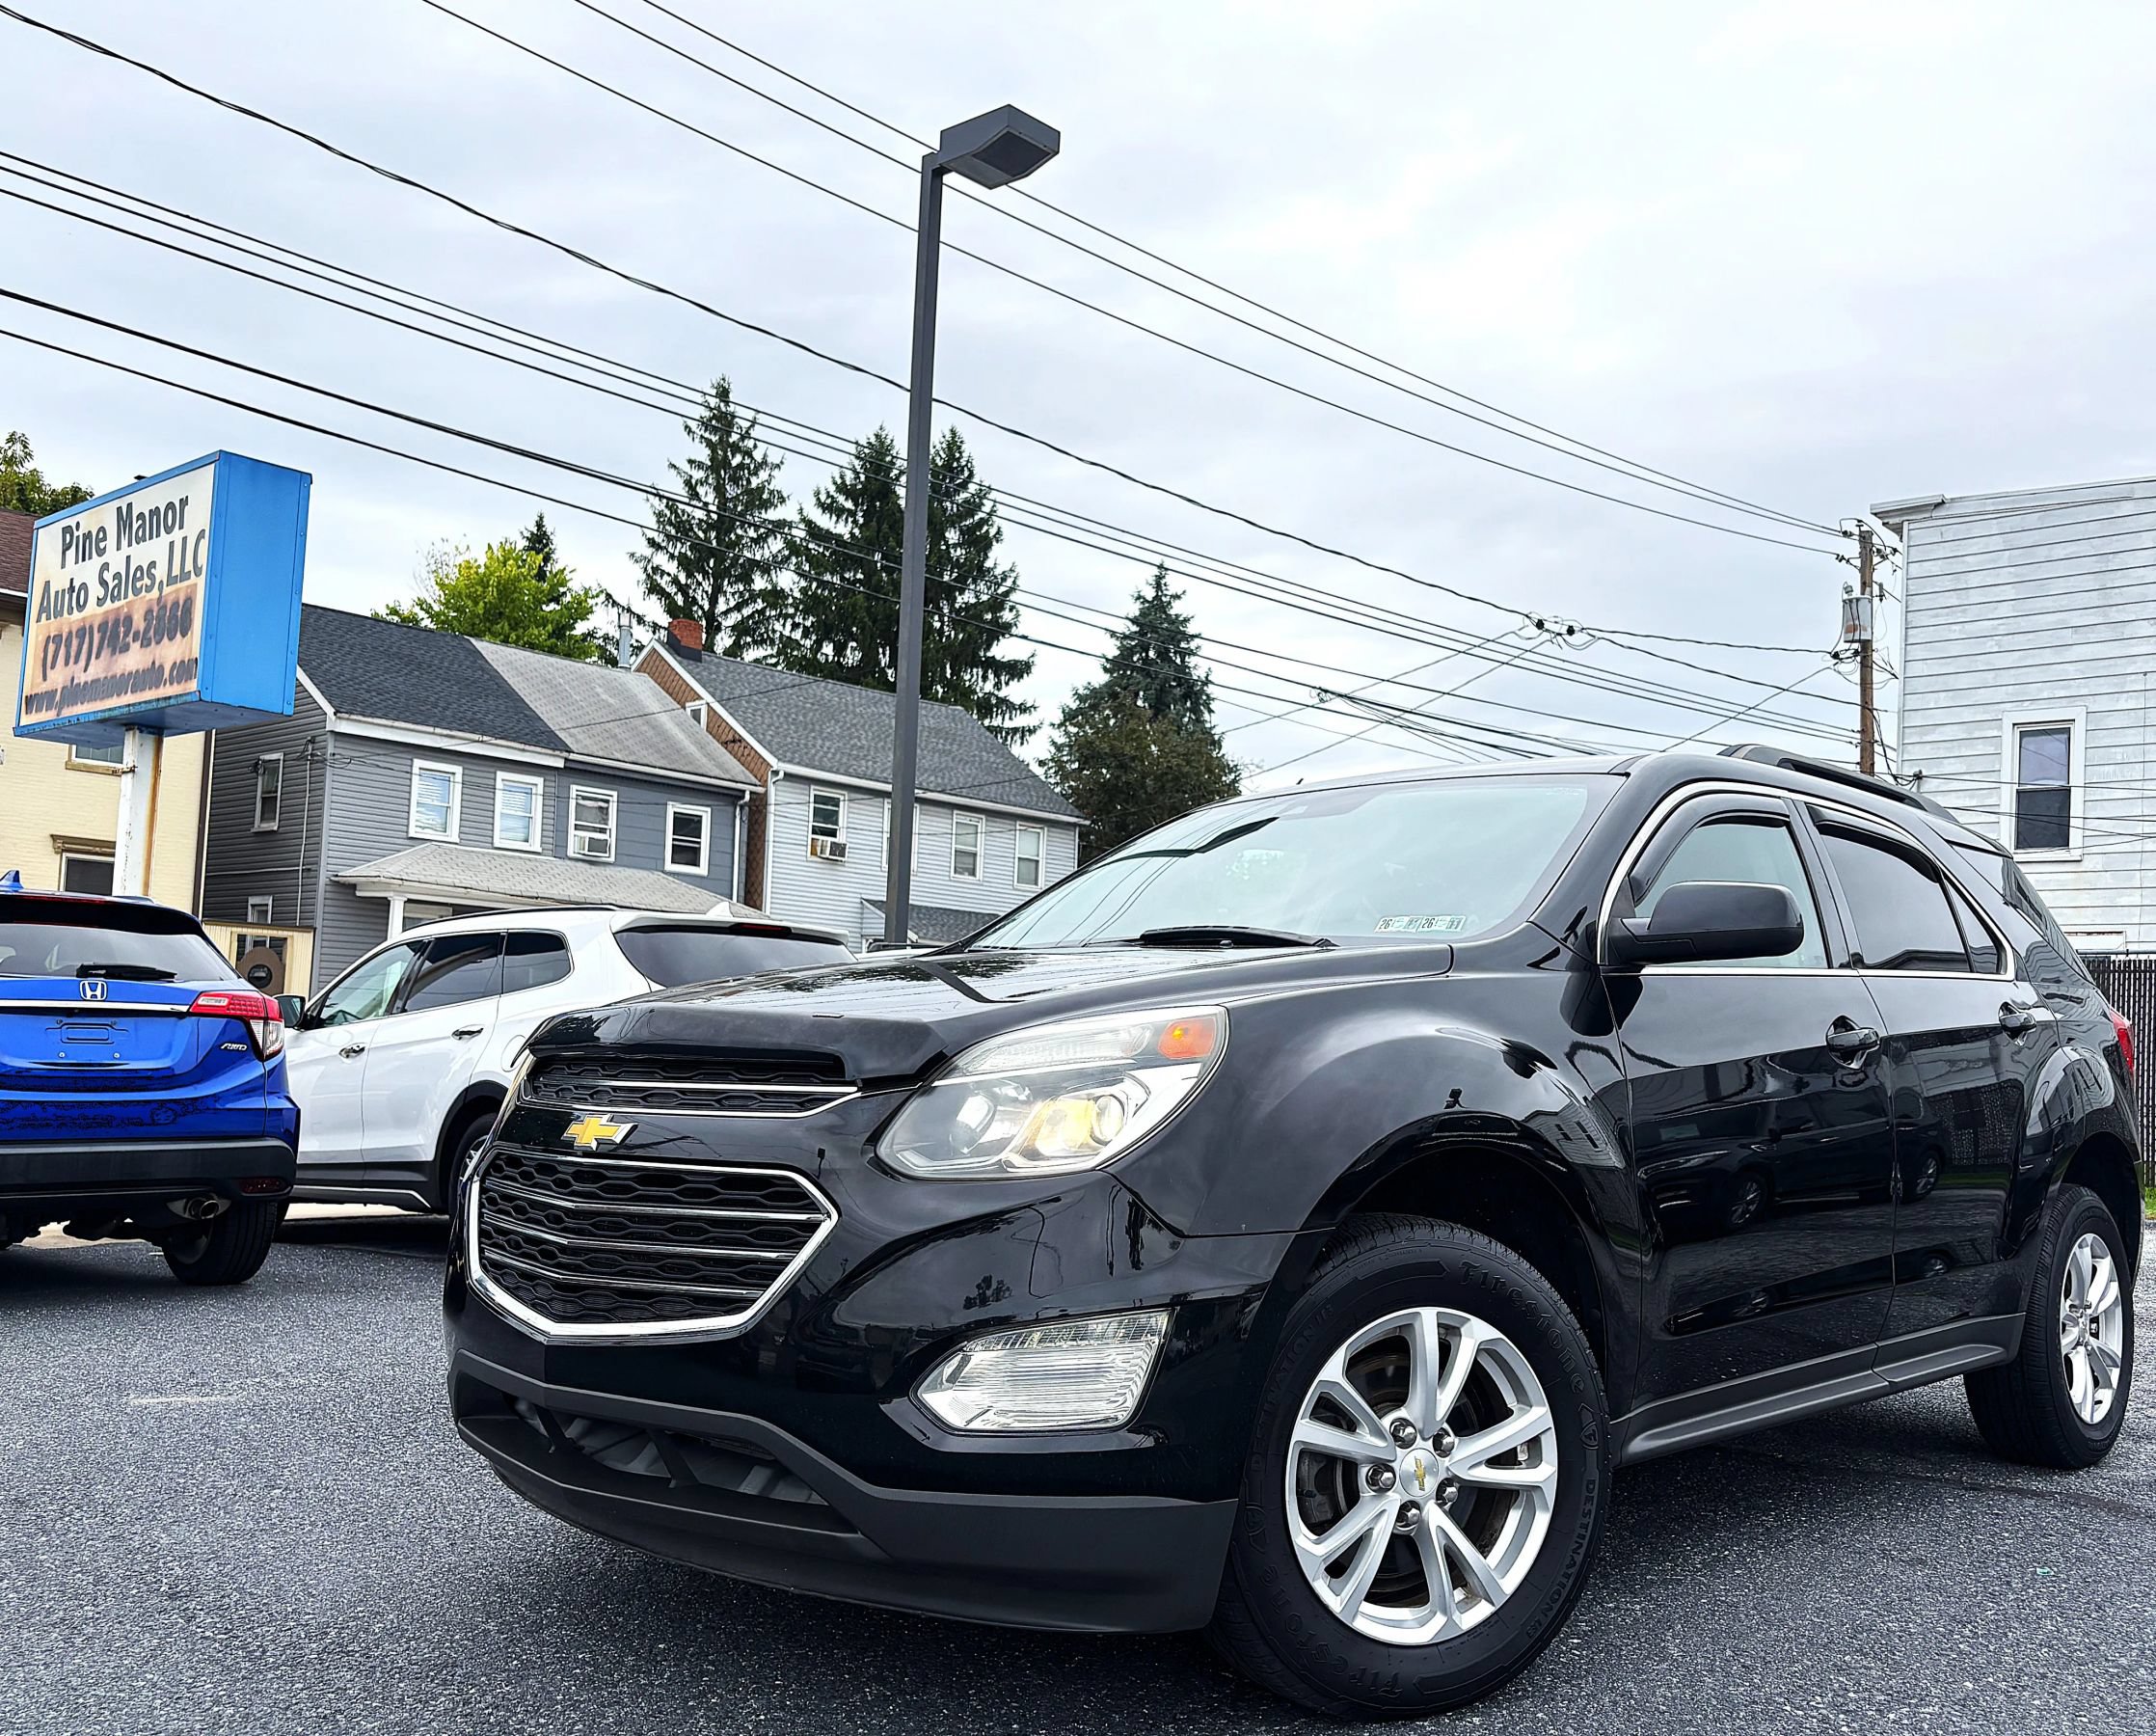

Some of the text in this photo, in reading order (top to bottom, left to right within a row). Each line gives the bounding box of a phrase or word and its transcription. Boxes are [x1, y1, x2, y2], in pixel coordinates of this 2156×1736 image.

[60, 495, 189, 569] Pine Manor
[36, 580, 89, 623] Auto
[1457, 1260, 1585, 1394] Firestone
[1541, 1478, 1598, 1620] DESTINATION
